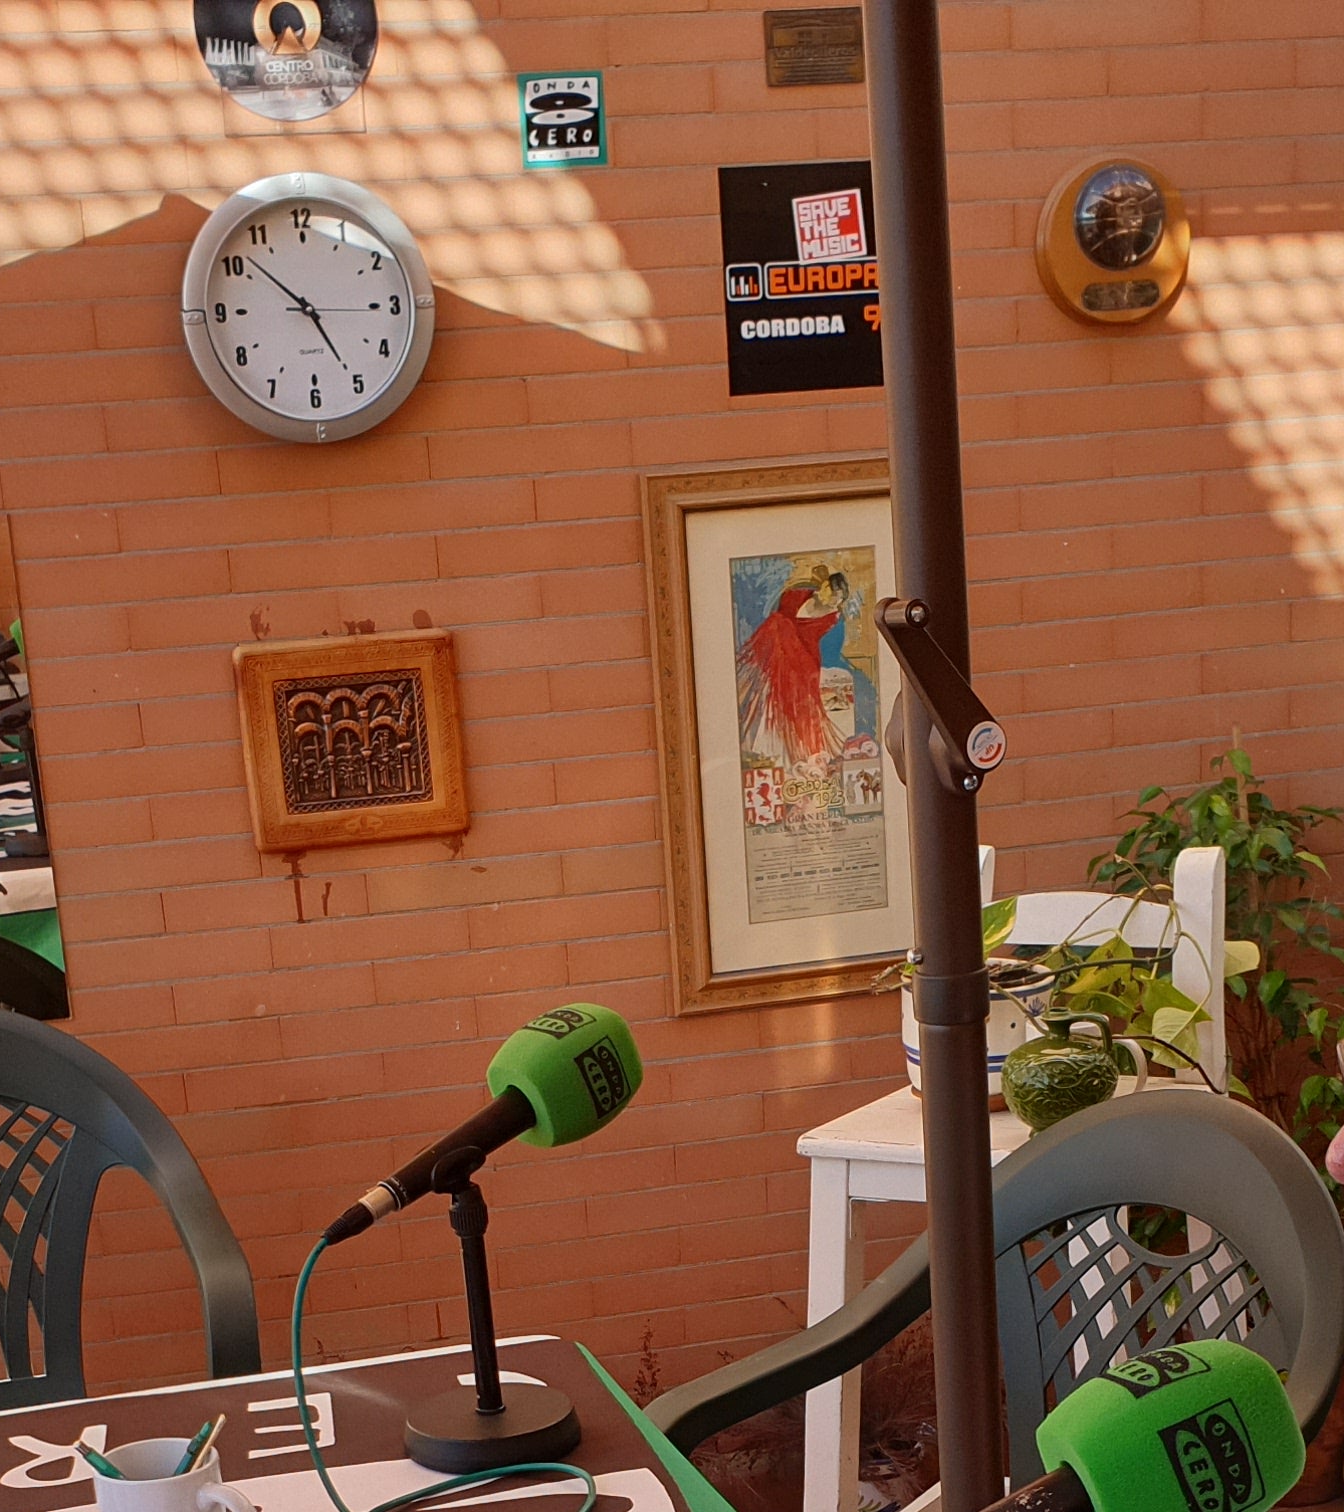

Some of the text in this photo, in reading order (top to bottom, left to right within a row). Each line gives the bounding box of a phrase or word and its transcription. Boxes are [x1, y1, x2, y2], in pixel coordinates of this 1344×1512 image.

[266, 60, 314, 72] CENTRO
[533, 80, 590, 94] ONDA
[528, 127, 592, 146] CERO
[290, 208, 312, 229] 12
[799, 196, 851, 221] SAVE
[248, 225, 267, 245] 11
[338, 219, 346, 242] 1
[801, 216, 840, 240] THE
[801, 232, 860, 260] MUSIC
[222, 256, 244, 276] 10
[371, 251, 382, 271] 2
[768, 262, 880, 294] EUROPA
[215, 302, 227, 324] 9
[389, 295, 401, 316] 3
[740, 315, 846, 340] CORDOBA
[236, 346, 248, 366] 8
[378, 338, 390, 358] 4
[267, 379, 277, 399] 7
[352, 374, 364, 394] 5
[310, 388, 322, 409] 6
[1212, 1422, 1248, 1498] ONDA
